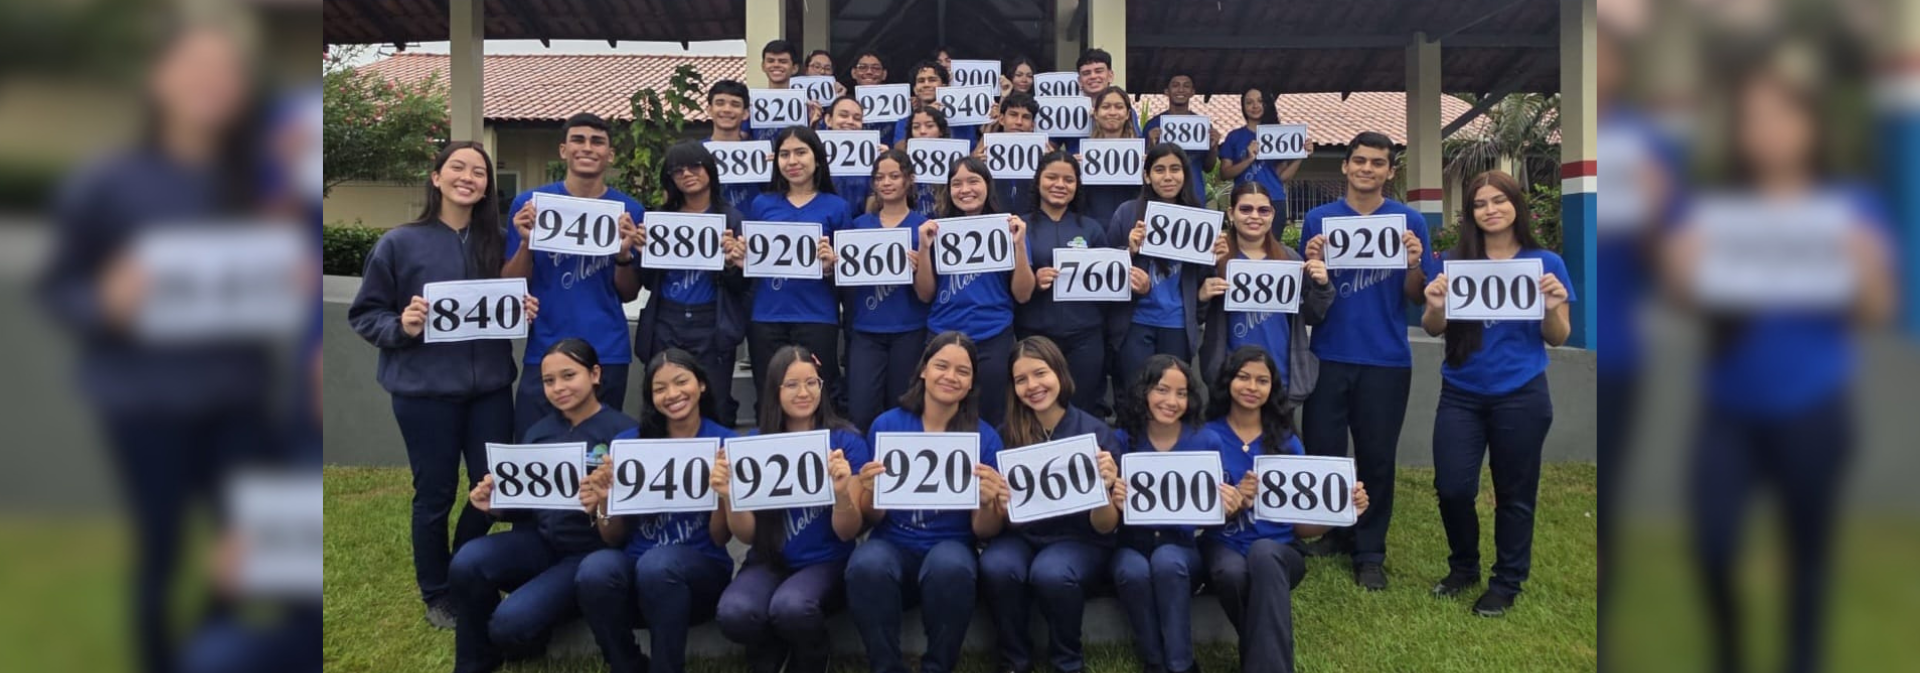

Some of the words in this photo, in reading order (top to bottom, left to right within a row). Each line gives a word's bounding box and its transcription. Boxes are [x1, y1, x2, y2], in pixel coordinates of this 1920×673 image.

[792, 81, 833, 100] 60
[862, 94, 906, 116] 920
[941, 92, 989, 119] 840
[754, 98, 802, 122] 820
[1038, 105, 1088, 131] 800
[1164, 122, 1206, 143] 880
[1261, 133, 1303, 154] 860
[989, 144, 1040, 171] 800
[1085, 148, 1140, 175] 800
[538, 210, 616, 248] 940
[649, 225, 718, 258] 880
[1147, 214, 1215, 253] 800
[1328, 226, 1399, 258] 920
[749, 234, 816, 267] 920
[840, 242, 906, 276] 860
[941, 229, 1008, 266] 820
[1059, 261, 1126, 293] 760
[1232, 272, 1295, 304] 880
[1452, 274, 1536, 310] 900
[433, 295, 520, 332] 840
[496, 461, 580, 497] 880
[617, 457, 709, 502] 940
[735, 451, 824, 500] 920
[883, 449, 972, 493] 920
[1008, 453, 1096, 507] 960
[1130, 470, 1217, 512] 800
[1261, 469, 1346, 512] 880
